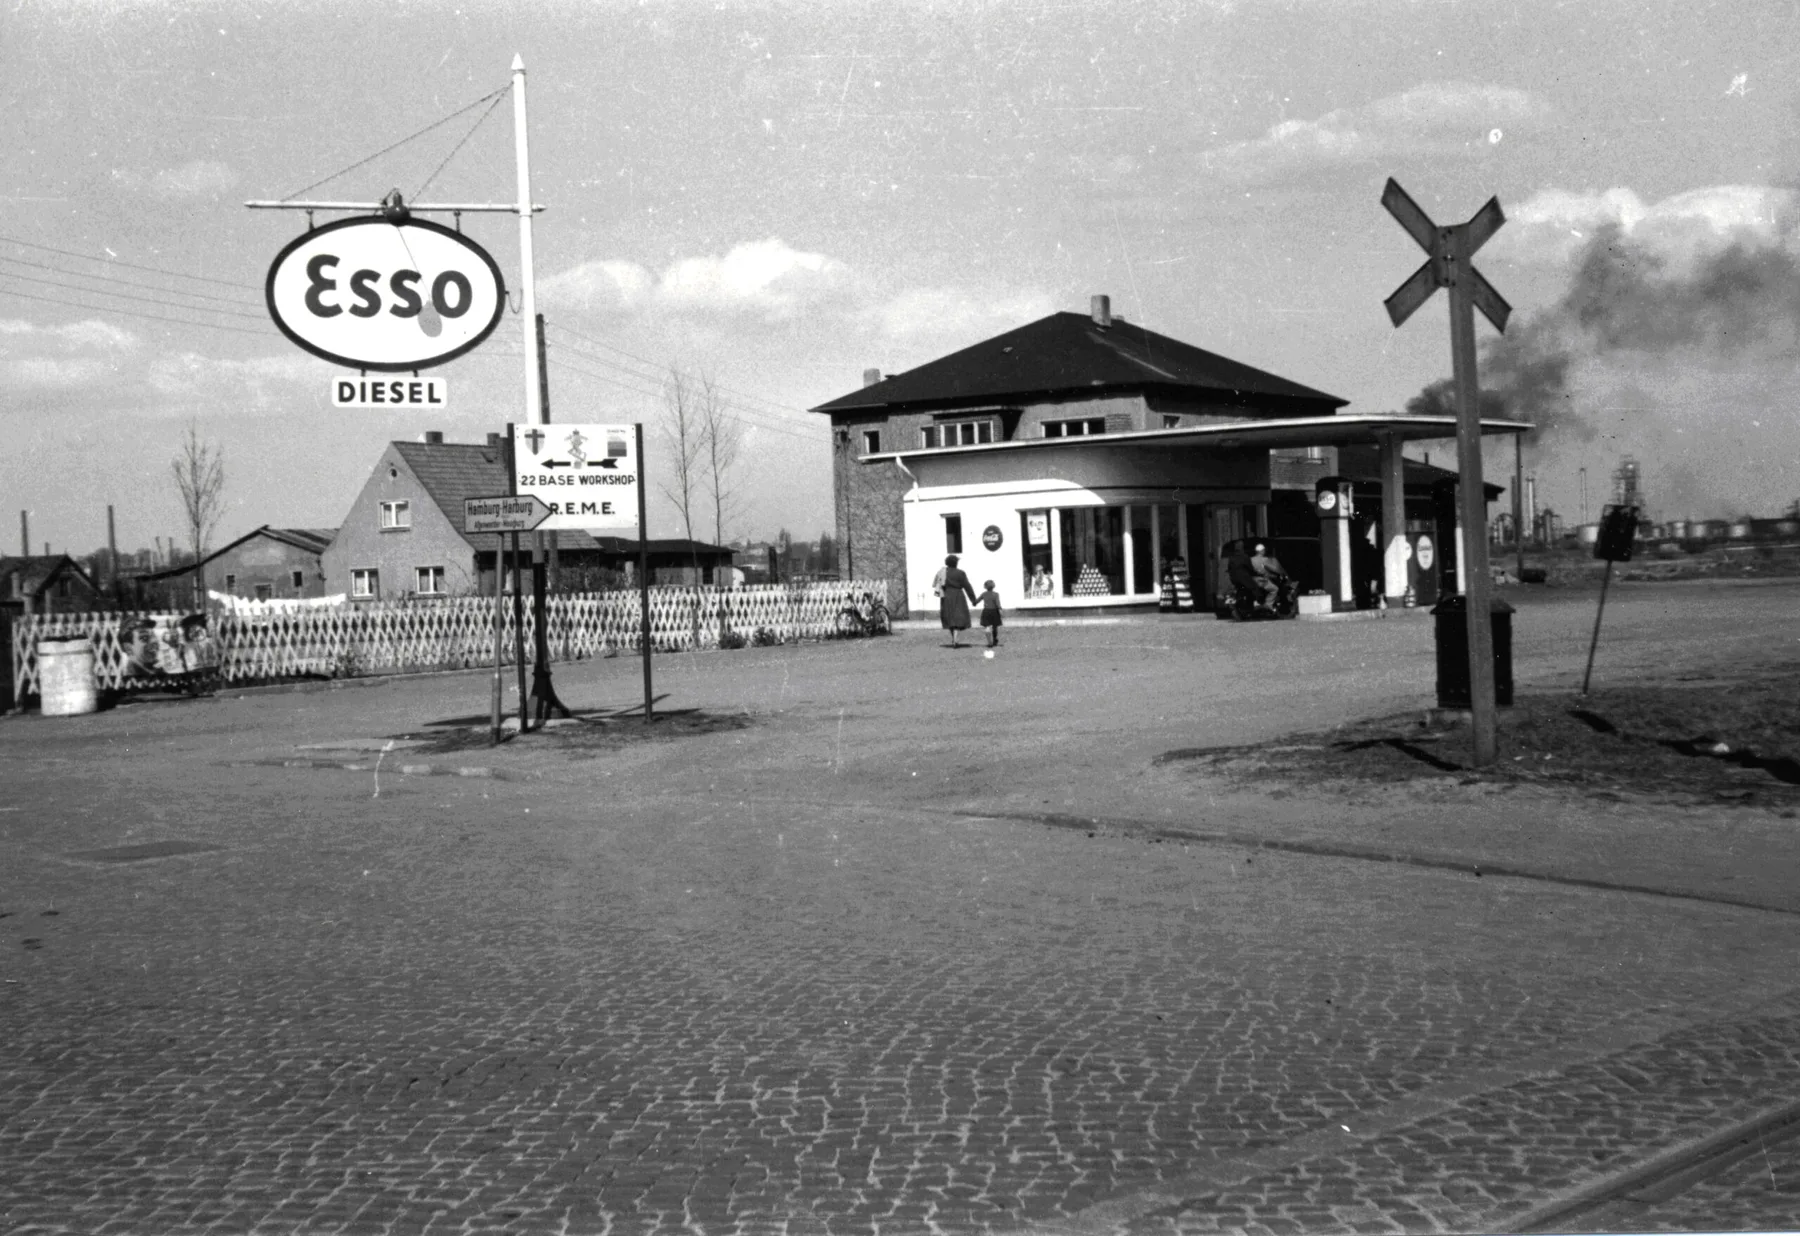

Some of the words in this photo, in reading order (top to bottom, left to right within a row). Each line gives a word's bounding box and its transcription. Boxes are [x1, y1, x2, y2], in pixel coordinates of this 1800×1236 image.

[338, 381, 441, 404] DIESEL
[521, 475, 536, 486] 22
[538, 475, 575, 486] BASE
[578, 475, 636, 486] WORKSHOP
